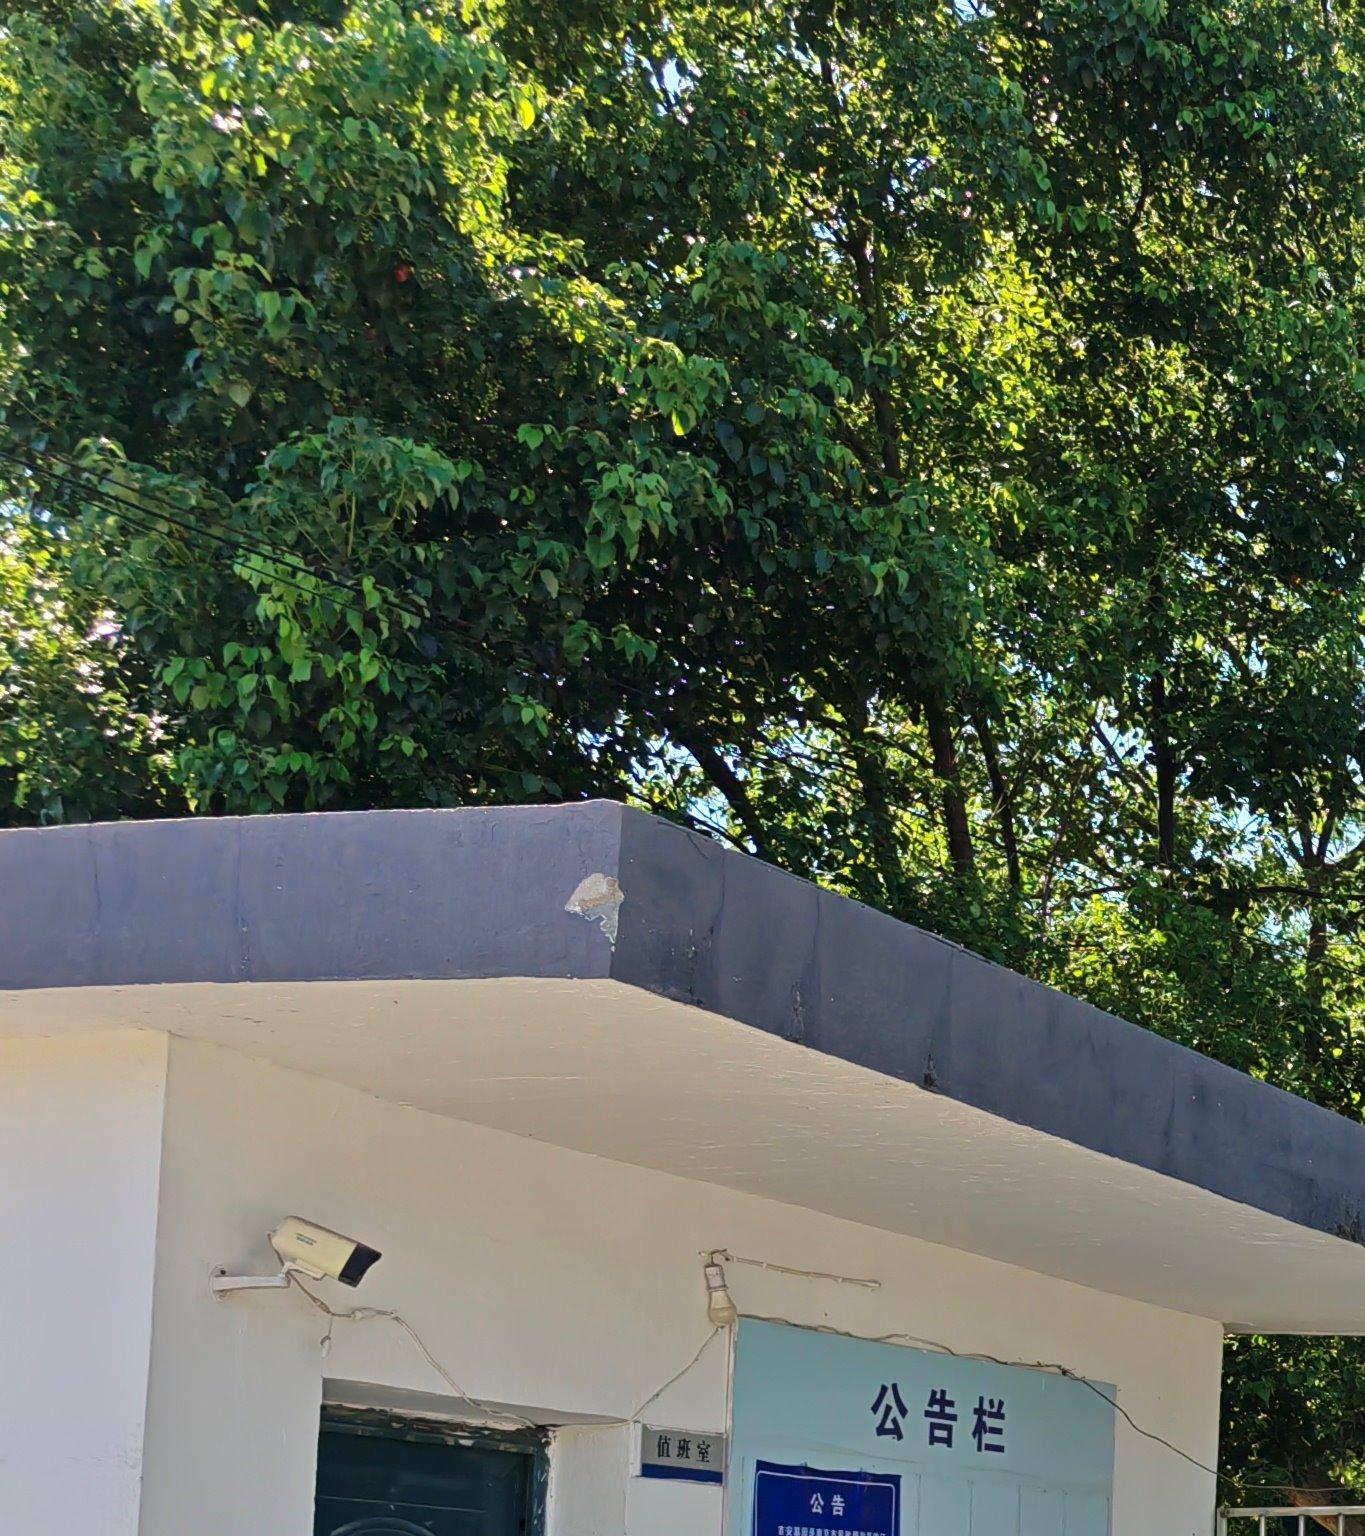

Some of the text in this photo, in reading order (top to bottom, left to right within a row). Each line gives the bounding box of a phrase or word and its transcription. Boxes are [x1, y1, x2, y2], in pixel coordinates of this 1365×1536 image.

[871, 1383, 1007, 1453] 公告栏
[657, 1434, 711, 1463] 值班室
[810, 1492, 845, 1516] 公告
